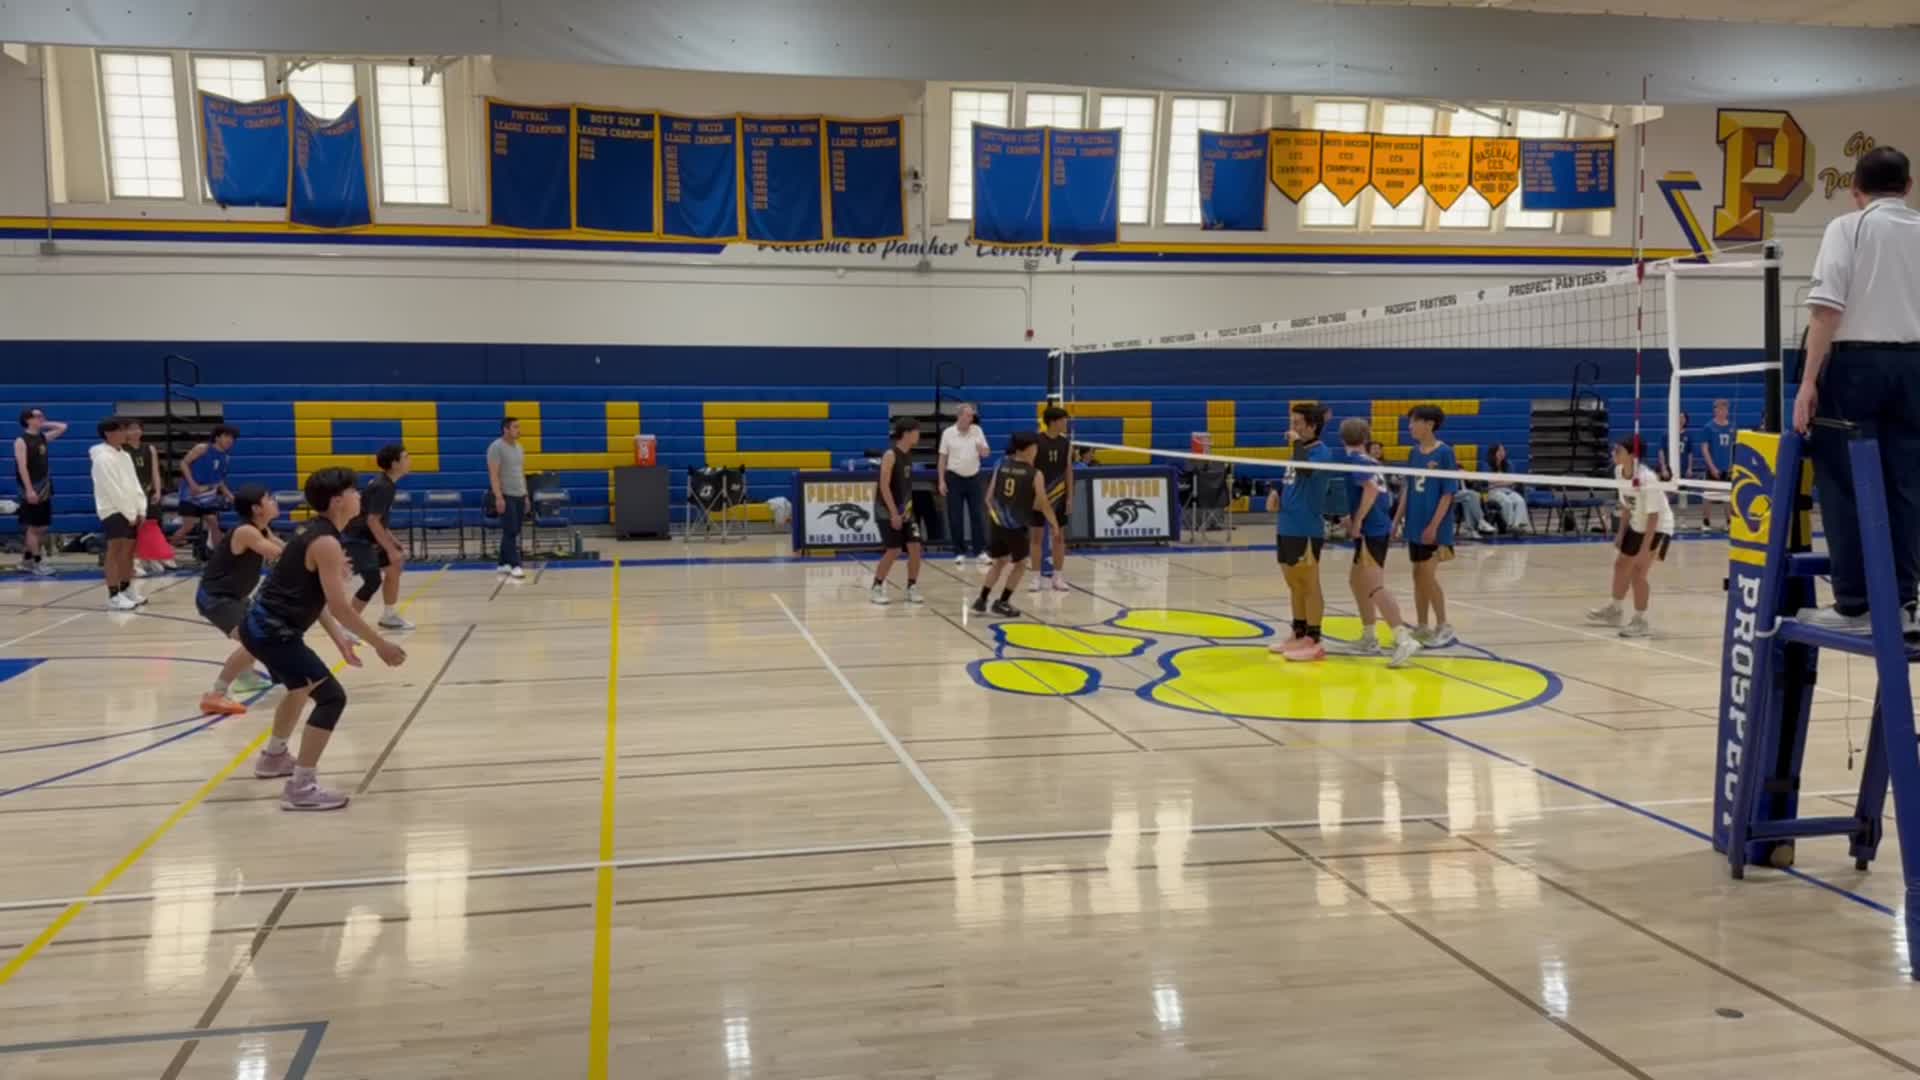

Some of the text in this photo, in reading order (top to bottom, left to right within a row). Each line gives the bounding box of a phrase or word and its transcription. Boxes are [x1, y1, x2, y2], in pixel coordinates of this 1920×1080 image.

[1713, 108, 1806, 241] P
[1508, 270, 1608, 297] PROSPECT PANTHERS
[1384, 294, 1457, 316] PROSPECT PANTHERS
[807, 484, 877, 503] PROSPEC
[1003, 477, 1016, 498] 9
[1101, 479, 1160, 498] PANTHER
[808, 533, 877, 544] HIGH SCHOOL
[1103, 527, 1161, 537] TERRITORY
[1723, 573, 1761, 826] PROSPEC
